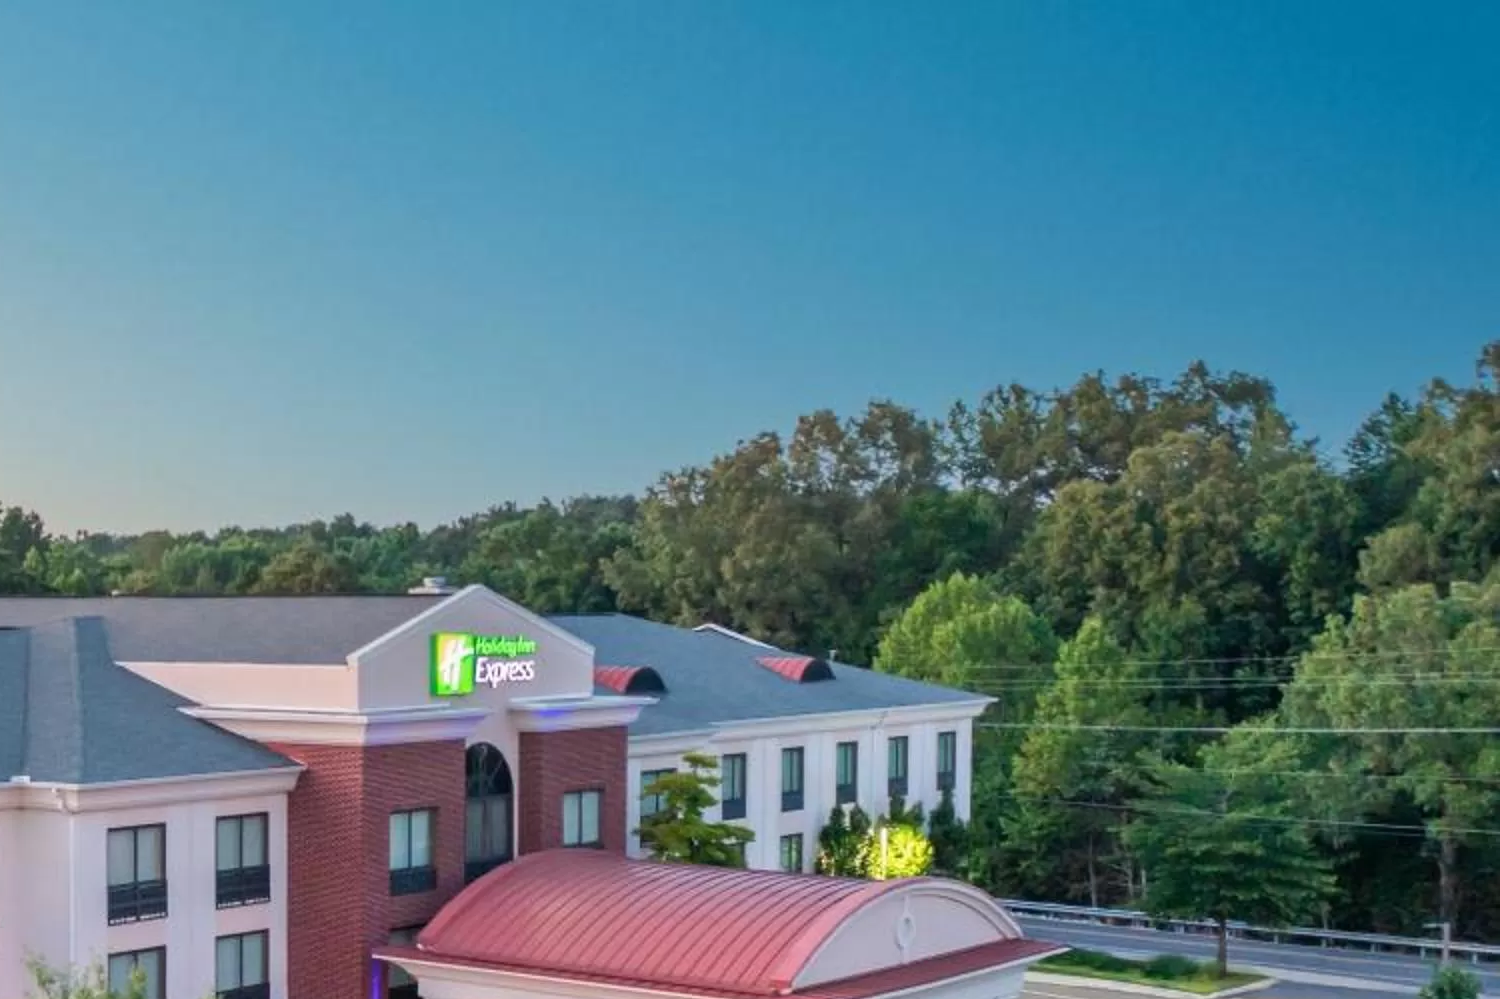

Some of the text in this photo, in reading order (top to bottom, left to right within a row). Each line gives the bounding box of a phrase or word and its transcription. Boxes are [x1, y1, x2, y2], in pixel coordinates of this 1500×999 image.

[475, 634, 536, 658] Holiday Inn
[475, 656, 535, 688] Express
